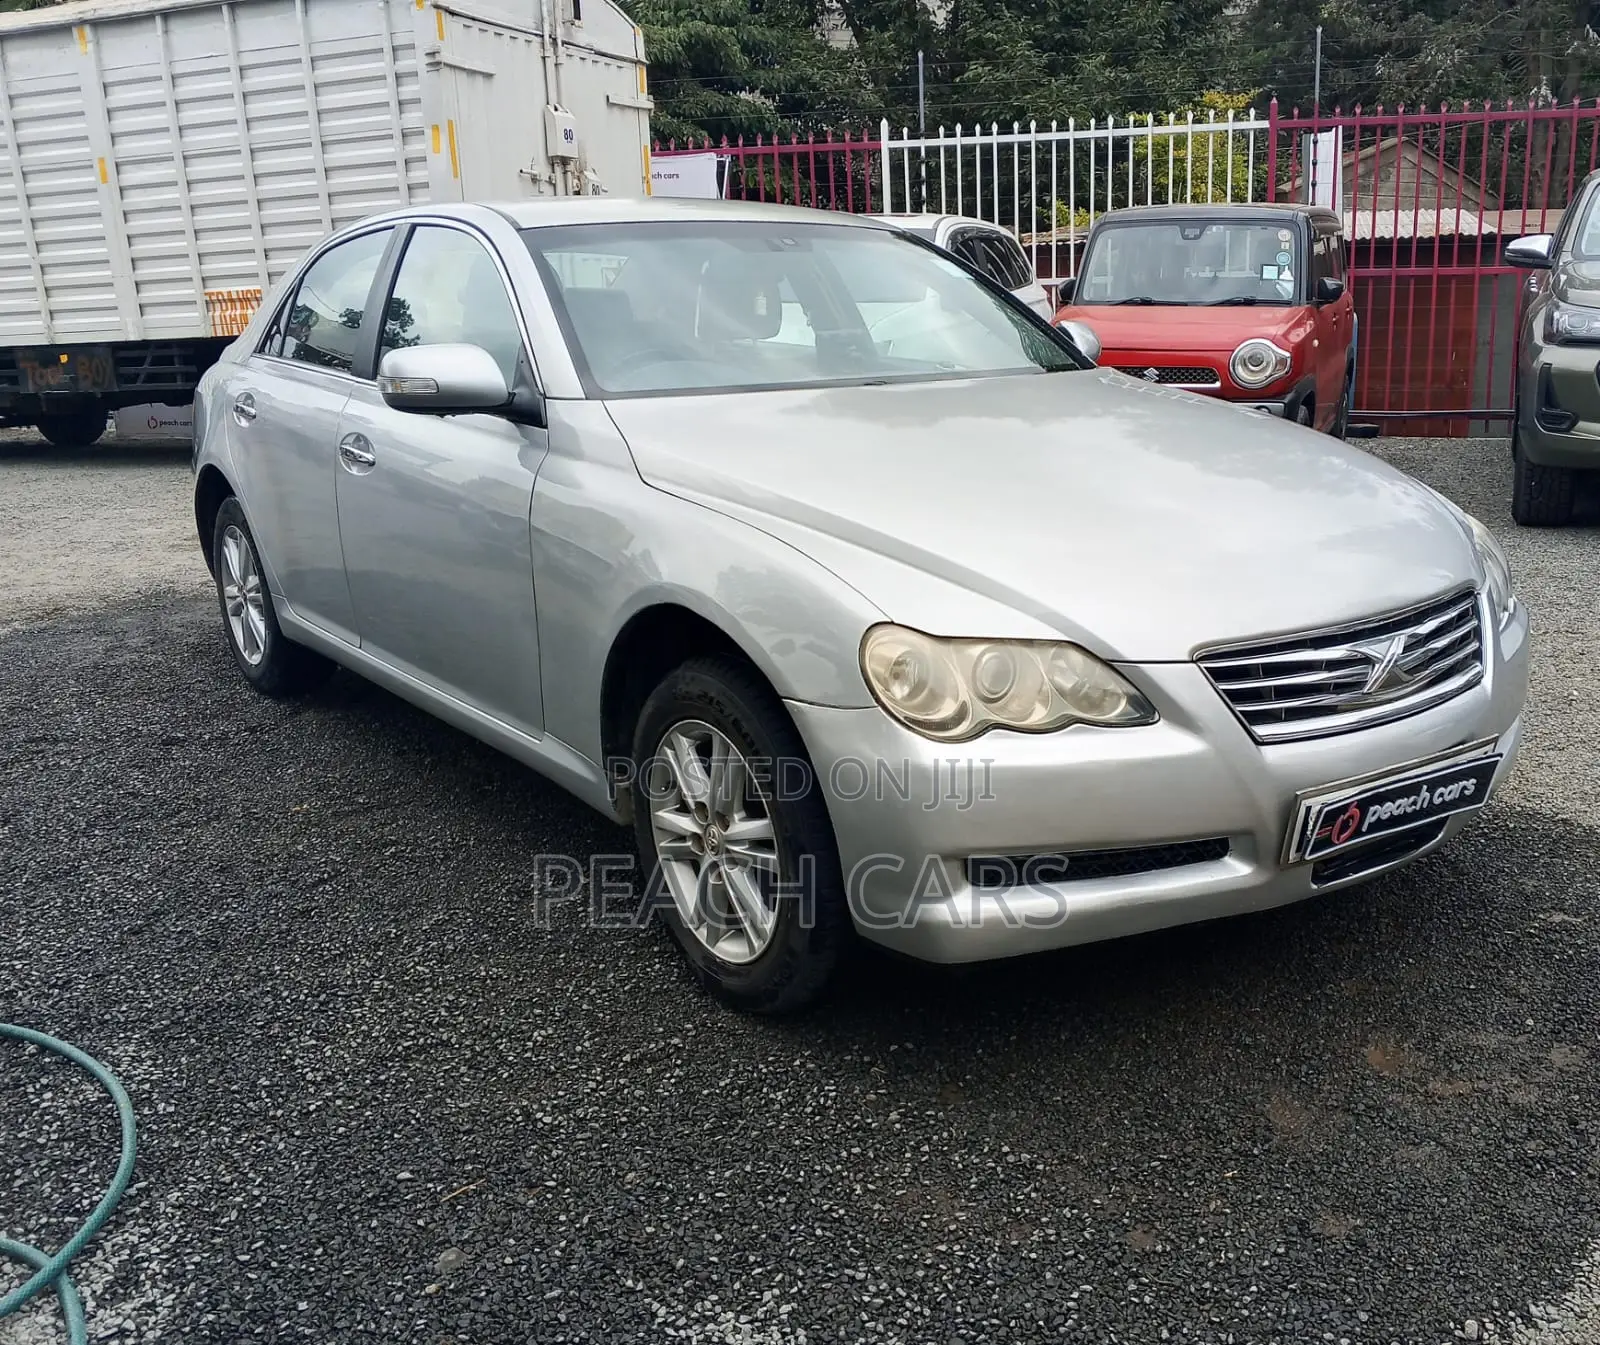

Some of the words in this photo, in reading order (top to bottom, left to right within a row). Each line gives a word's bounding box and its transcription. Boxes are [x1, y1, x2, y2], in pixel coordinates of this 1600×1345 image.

[563, 128, 574, 141] 80
[1361, 785, 1430, 832] peach
[1432, 778, 1478, 805] cars
